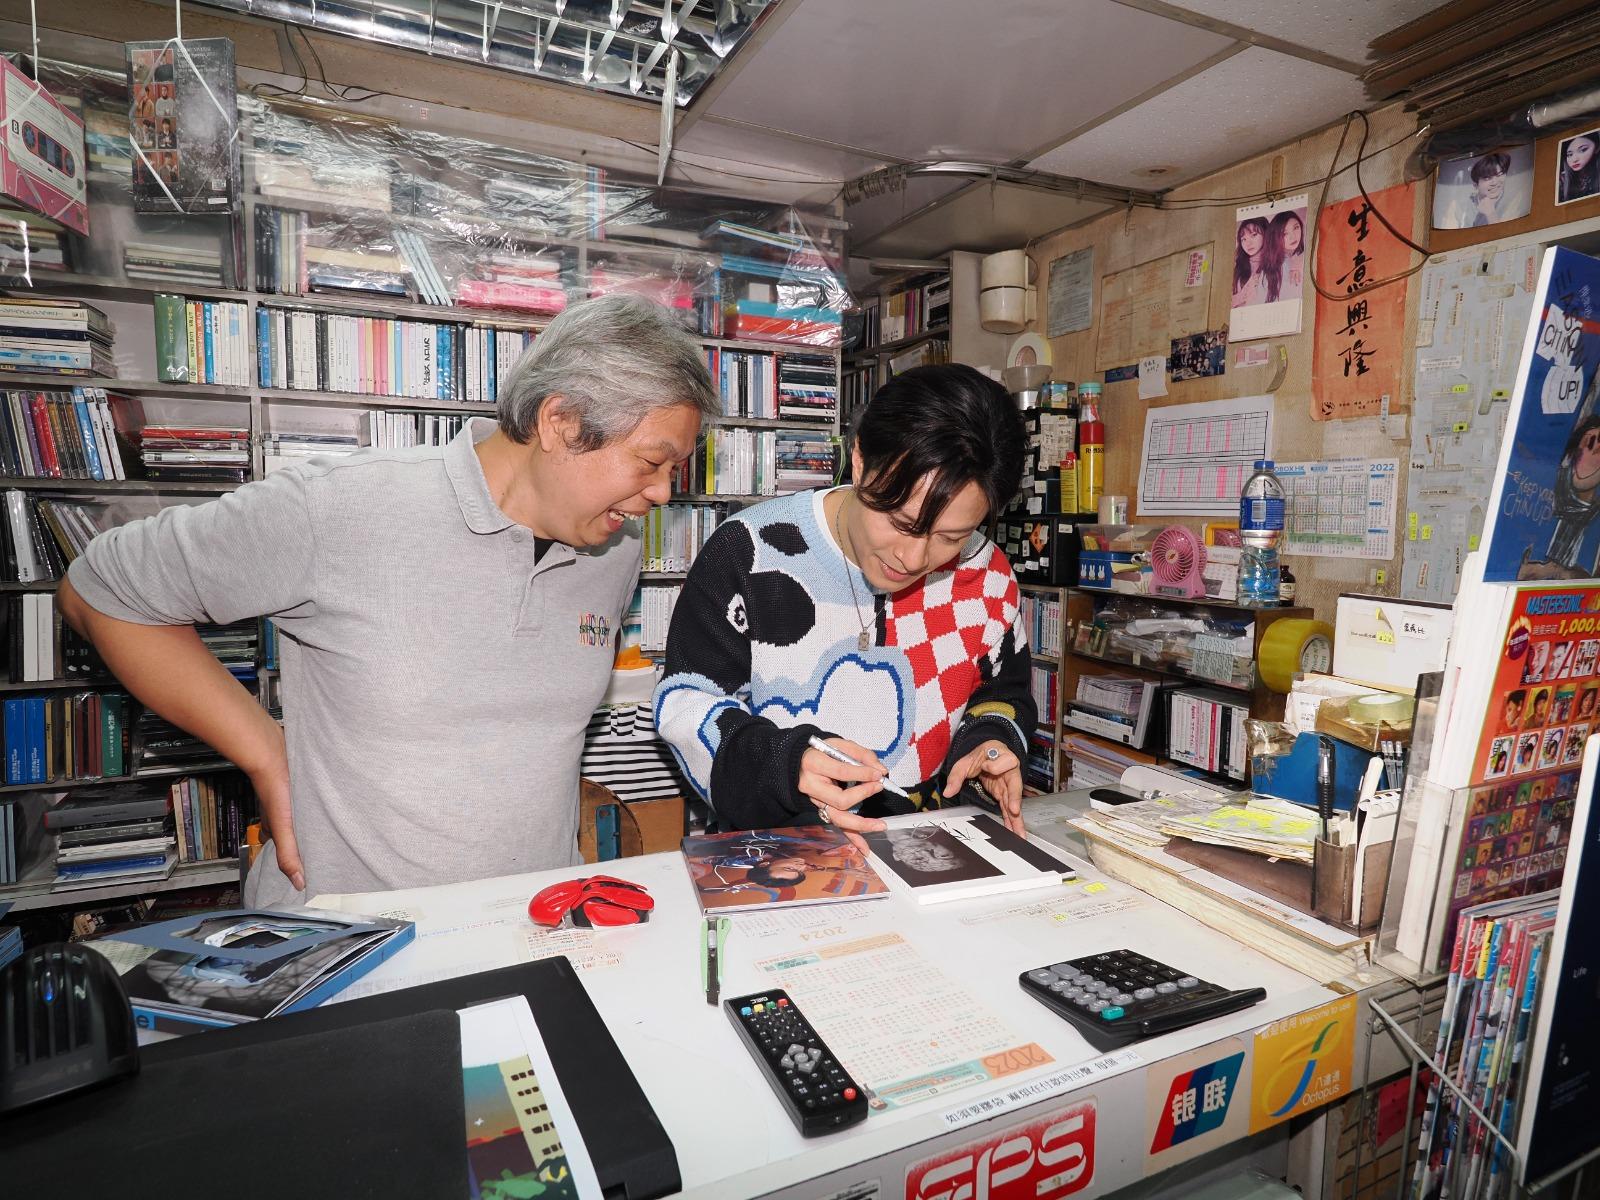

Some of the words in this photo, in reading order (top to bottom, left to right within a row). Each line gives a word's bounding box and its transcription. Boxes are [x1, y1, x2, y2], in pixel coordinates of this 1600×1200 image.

[1558, 380, 1580, 400] UP!
[1369, 463, 1395, 472] 2022
[1526, 594, 1584, 615] MASTERSONIC
[1171, 1076, 1227, 1126] 银联
[1302, 1084, 1340, 1106] Octopus
